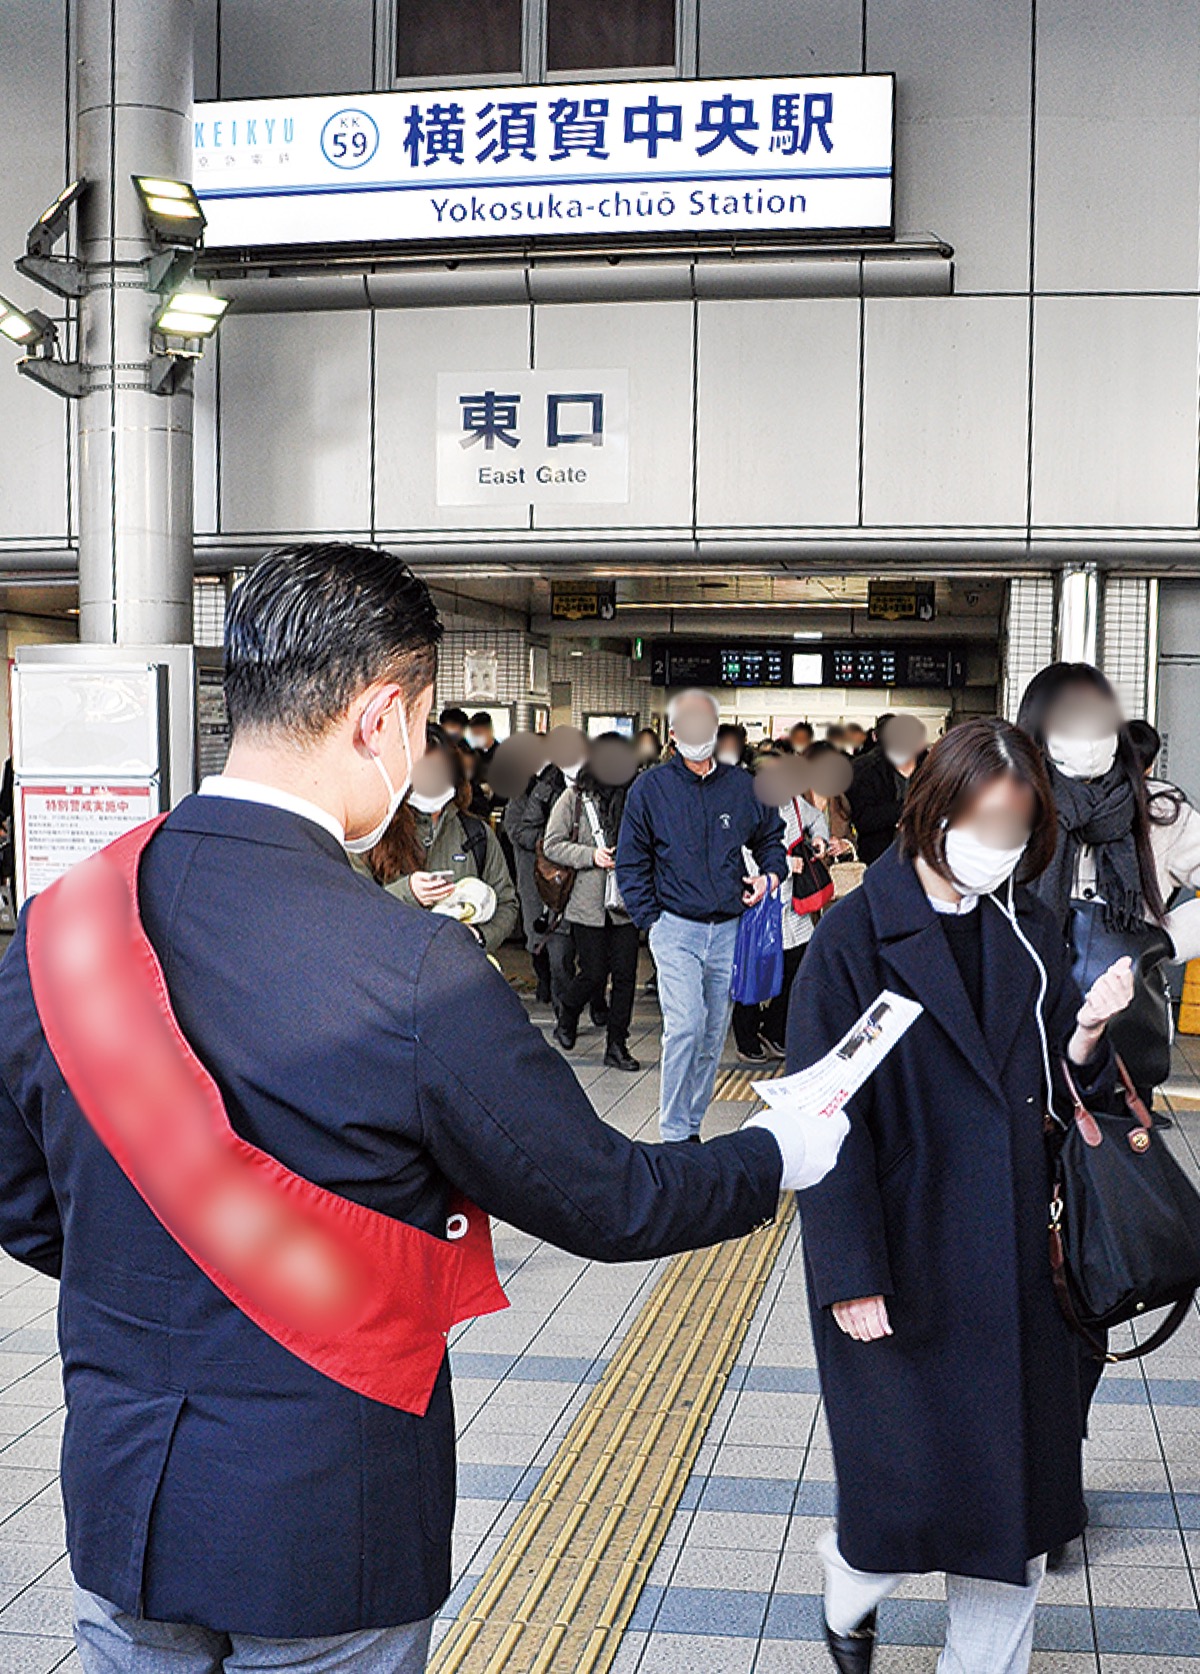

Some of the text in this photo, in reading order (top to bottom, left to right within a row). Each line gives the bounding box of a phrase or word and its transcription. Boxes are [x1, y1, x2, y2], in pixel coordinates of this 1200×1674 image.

[195, 117, 294, 149] KEIKYU
[339, 115, 361, 129] KK
[402, 92, 834, 168] 横須賀中央駅
[332, 132, 368, 159] 59
[431, 188, 807, 223] Yokosuka-chūō Station
[459, 391, 604, 450] 東口
[479, 465, 587, 485] East Gate
[655, 660, 664, 673] 2
